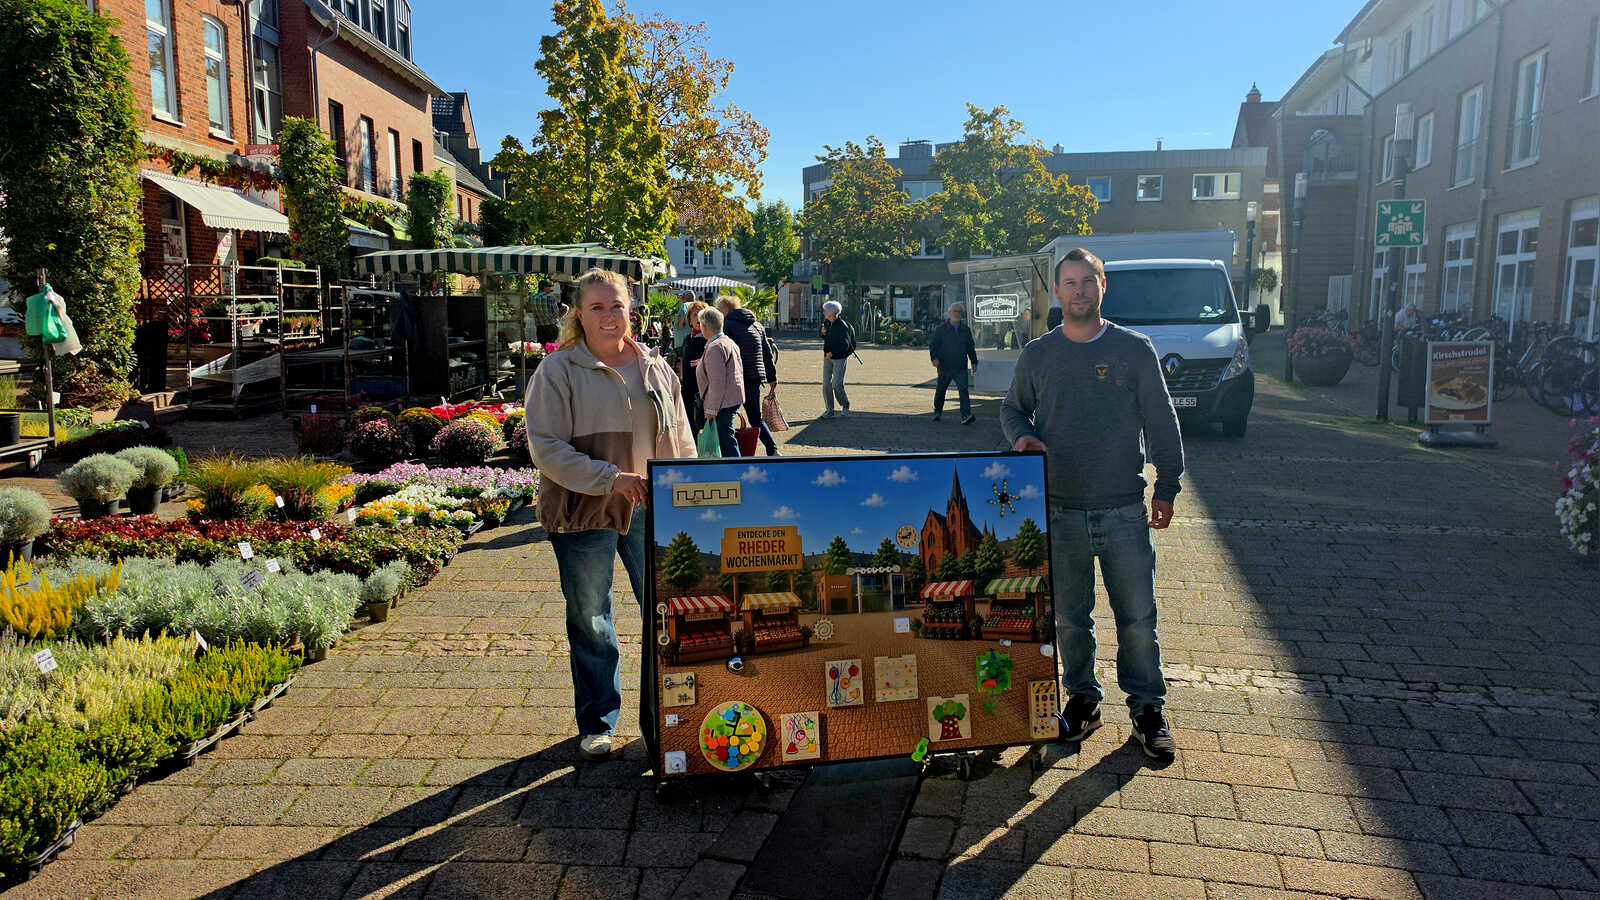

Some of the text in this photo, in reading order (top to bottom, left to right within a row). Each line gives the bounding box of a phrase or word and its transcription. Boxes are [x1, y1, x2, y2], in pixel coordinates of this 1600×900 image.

[1432, 346, 1488, 360] Kirschstrudel
[737, 529, 786, 539] ENTDECKE DEN
[738, 540, 786, 554] RHEDER
[725, 553, 800, 569] WOCHENMARKT
